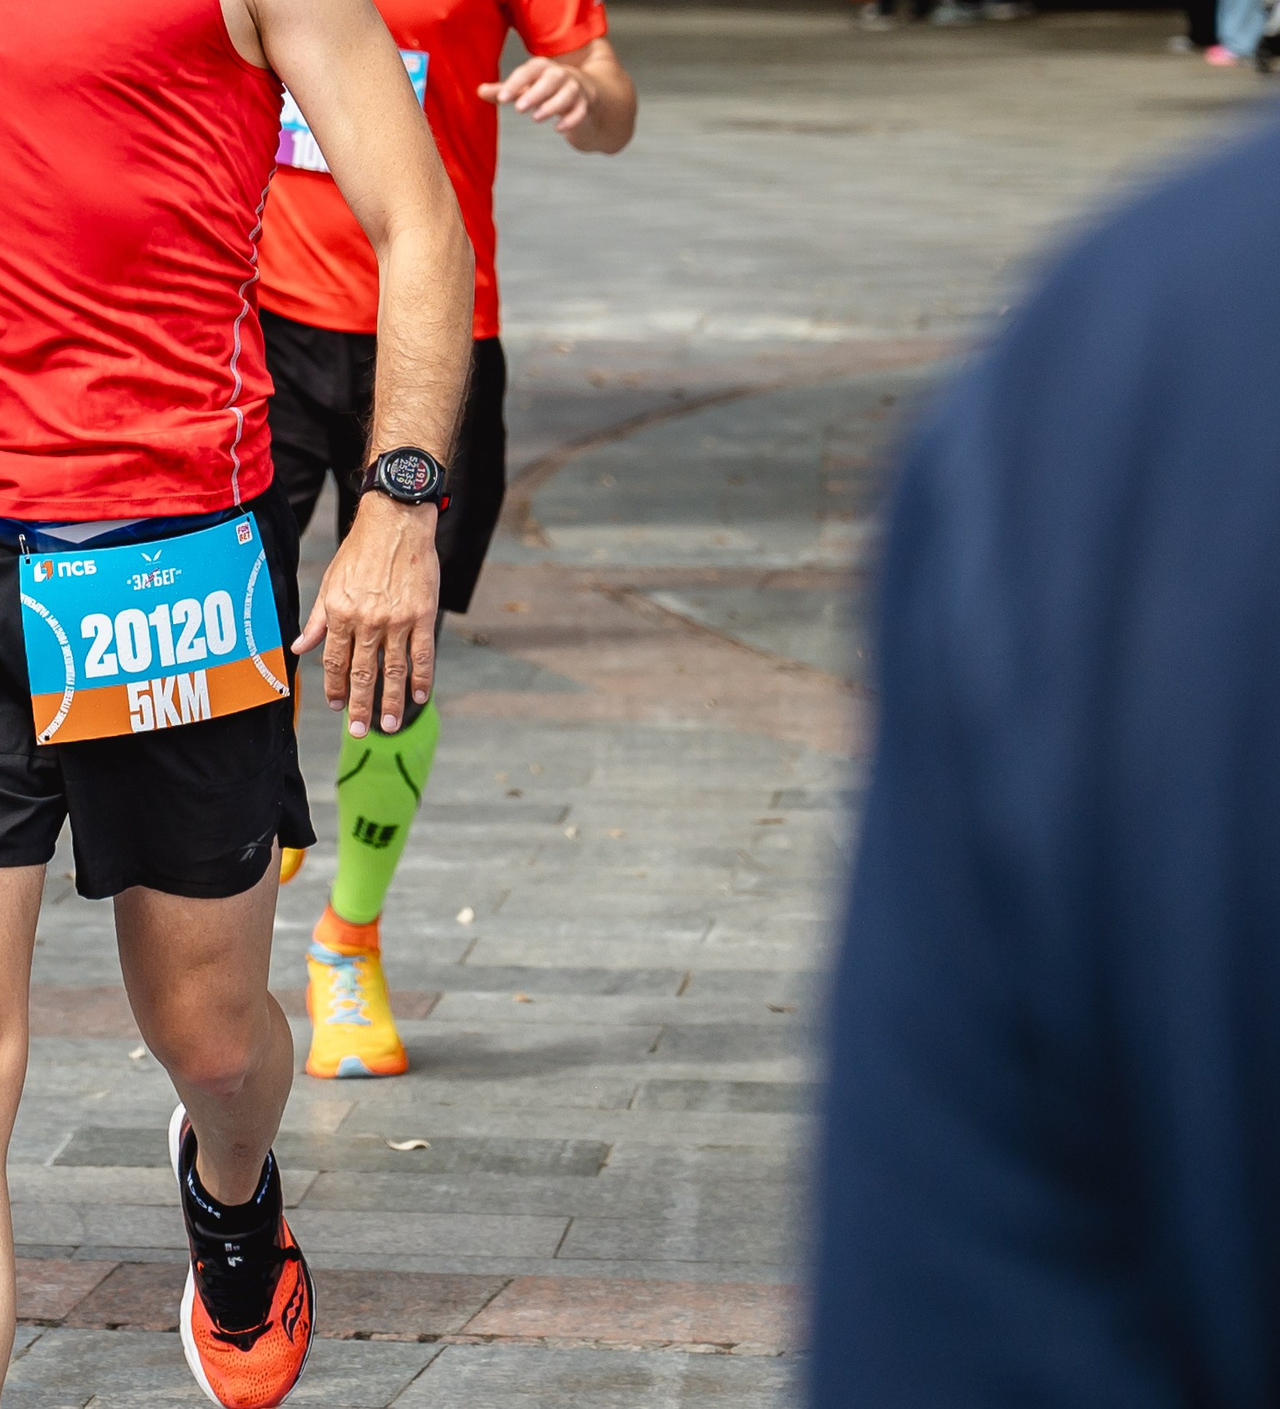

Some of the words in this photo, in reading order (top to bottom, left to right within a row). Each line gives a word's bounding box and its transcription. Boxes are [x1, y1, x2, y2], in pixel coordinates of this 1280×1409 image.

[415, 468, 426, 483] 191
[57, 559, 97, 578] ПСБ
[80, 590, 237, 678] 20120
